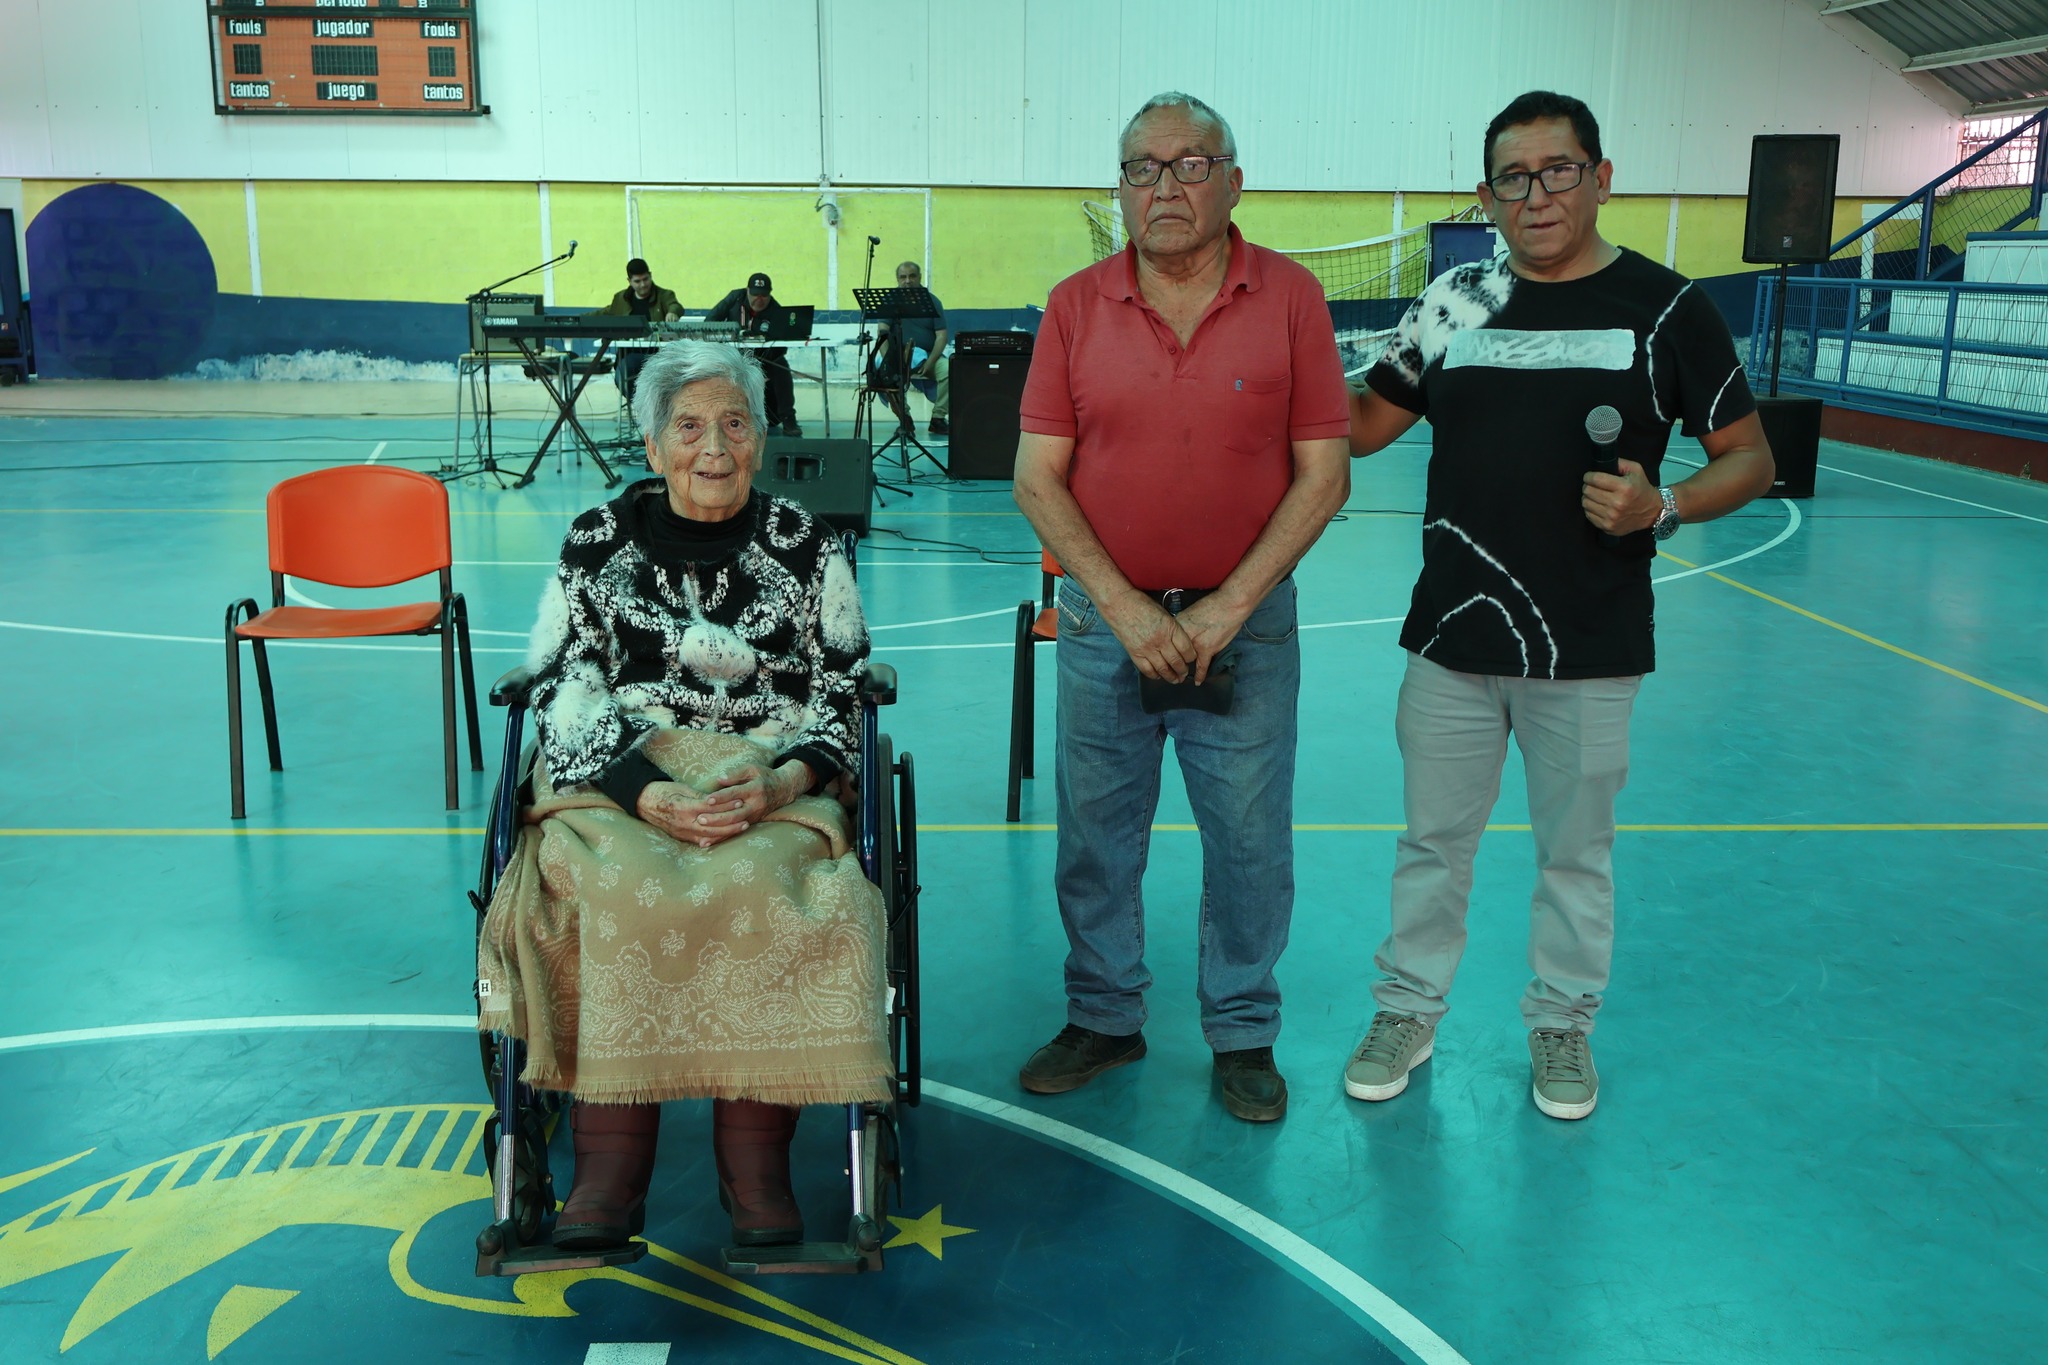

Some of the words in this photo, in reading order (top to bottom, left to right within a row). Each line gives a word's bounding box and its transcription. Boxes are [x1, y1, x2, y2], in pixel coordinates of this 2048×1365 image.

[229, 19, 262, 35] fouls
[315, 19, 370, 37] jugador
[424, 20, 456, 37] fouls
[229, 82, 270, 98] tantos
[327, 82, 365, 101] juego
[423, 84, 463, 101] tantos
[492, 317, 519, 326] YAMAHA
